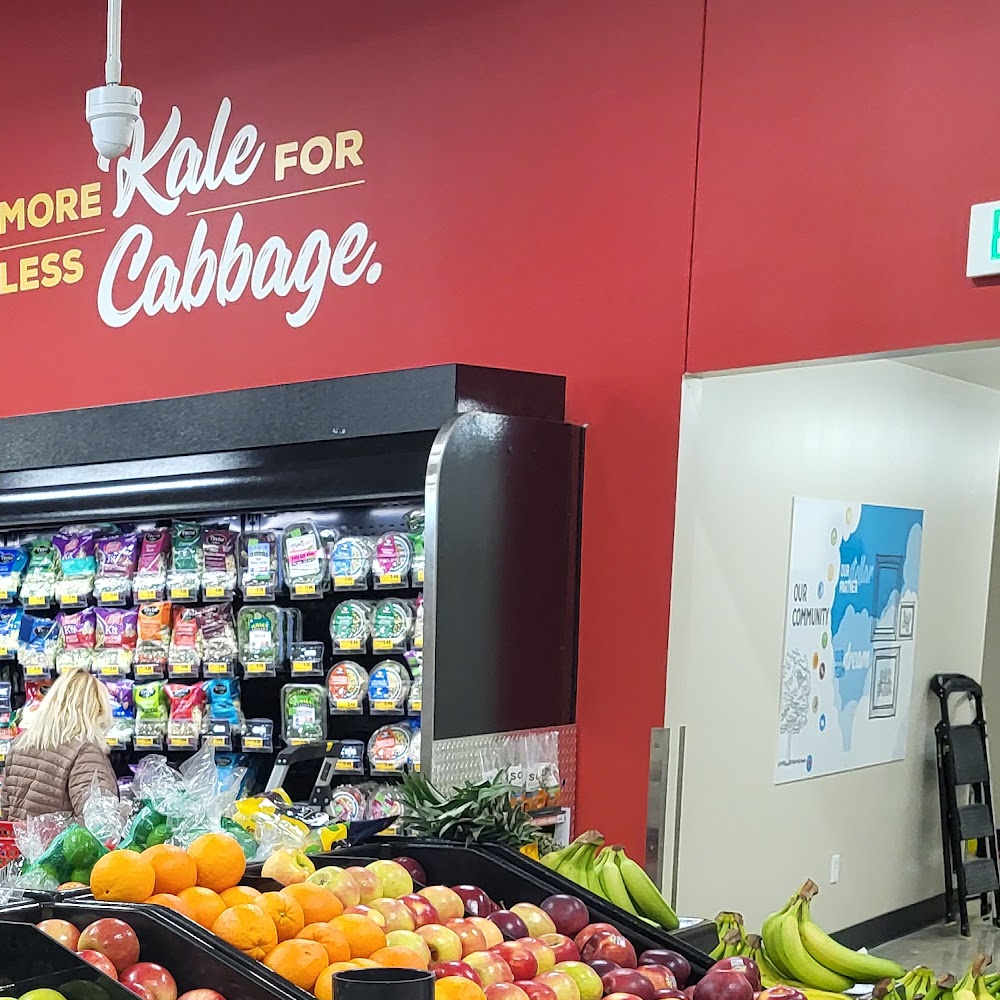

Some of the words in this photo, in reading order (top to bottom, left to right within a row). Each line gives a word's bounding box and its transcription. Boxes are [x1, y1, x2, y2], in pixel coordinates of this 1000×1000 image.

[98, 96, 265, 218] Kale
[275, 129, 364, 182] FOR
[0, 249, 84, 295] LESS
[97, 212, 383, 329] Cabbage.
[792, 607, 830, 627] COMMUNITY
[793, 583, 808, 602] OUR
